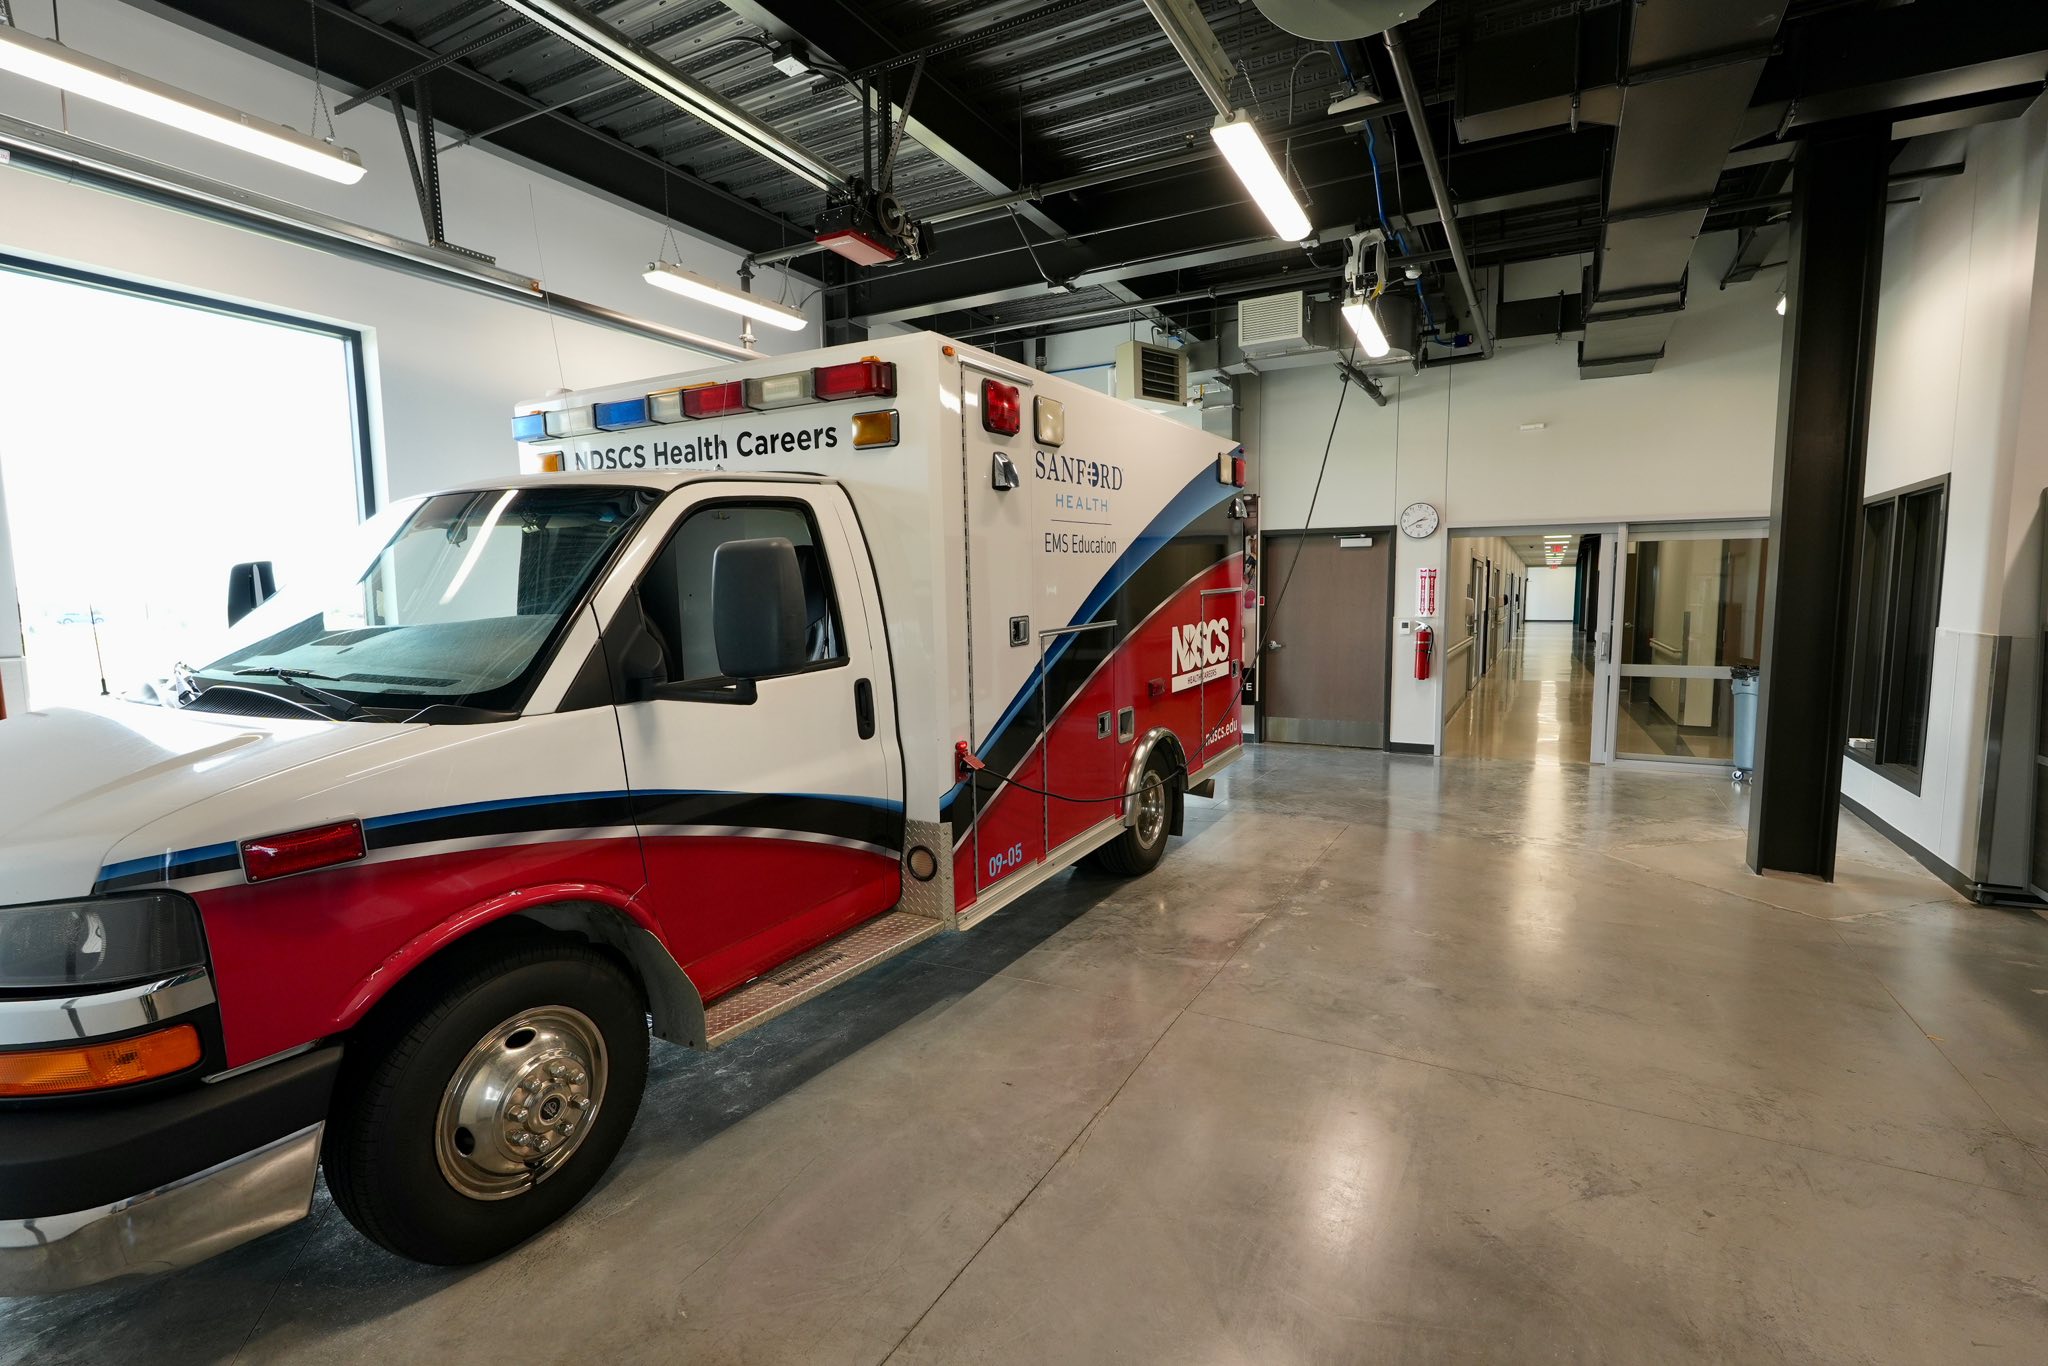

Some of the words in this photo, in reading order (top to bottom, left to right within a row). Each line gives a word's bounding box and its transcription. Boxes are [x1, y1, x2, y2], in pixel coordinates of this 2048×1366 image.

[575, 444, 646, 471] NDSCS
[653, 434, 728, 466] Health
[736, 426, 838, 457] Careers
[1035, 451, 1122, 490] SANFORD
[1055, 493, 1109, 513] HEALTH
[1044, 532, 1069, 554] EMS
[1072, 533, 1117, 555] Education
[1171, 617, 1230, 675] NDSCS
[989, 842, 1022, 877] 09-05
